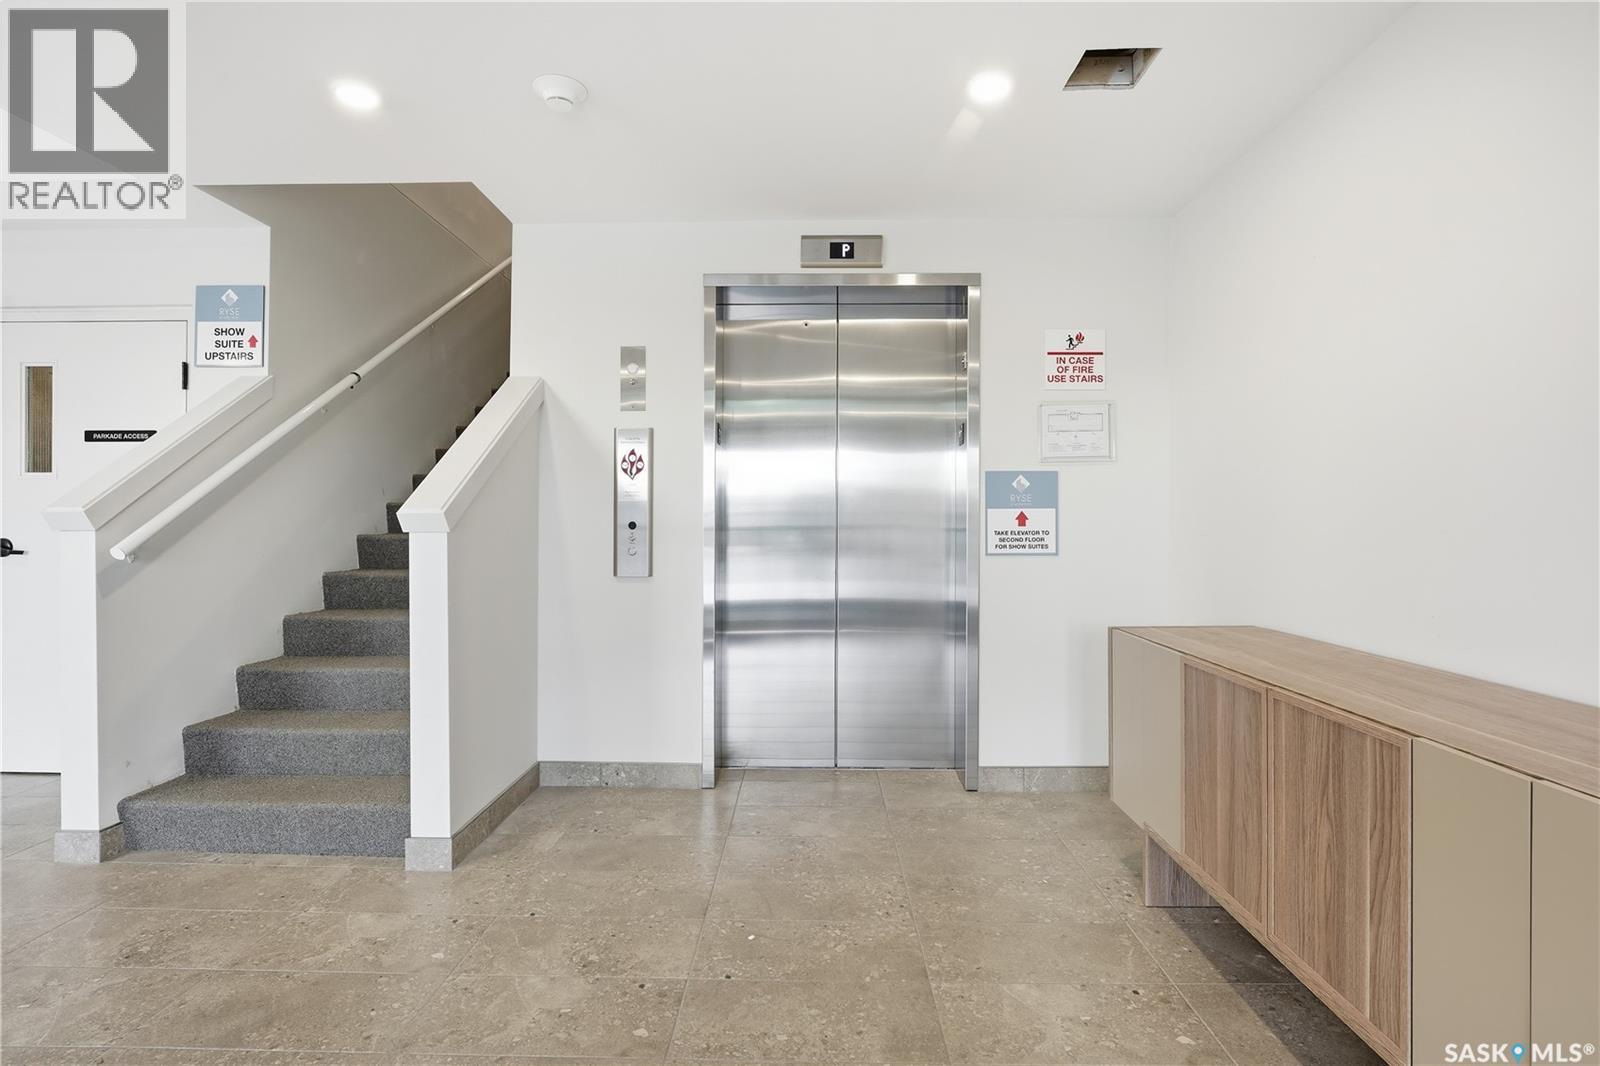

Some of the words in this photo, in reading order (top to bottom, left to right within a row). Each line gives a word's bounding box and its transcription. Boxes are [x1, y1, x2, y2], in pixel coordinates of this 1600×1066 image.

[842, 243, 851, 258] P
[218, 307, 240, 316] RYSE
[213, 327, 245, 336] SHOW
[214, 339, 244, 348] SUITE
[204, 351, 254, 361] UPSTAIRS
[1056, 356, 1066, 365] IN
[1068, 356, 1095, 365] CASE
[1056, 365, 1070, 374] OF
[1072, 365, 1094, 374] FIRE
[1047, 374, 1067, 383] USE
[1069, 374, 1104, 383] STAIRS
[92, 432, 122, 440] PARKADE
[123, 432, 149, 440] ACCESS
[1009, 494, 1032, 503] RYSE
